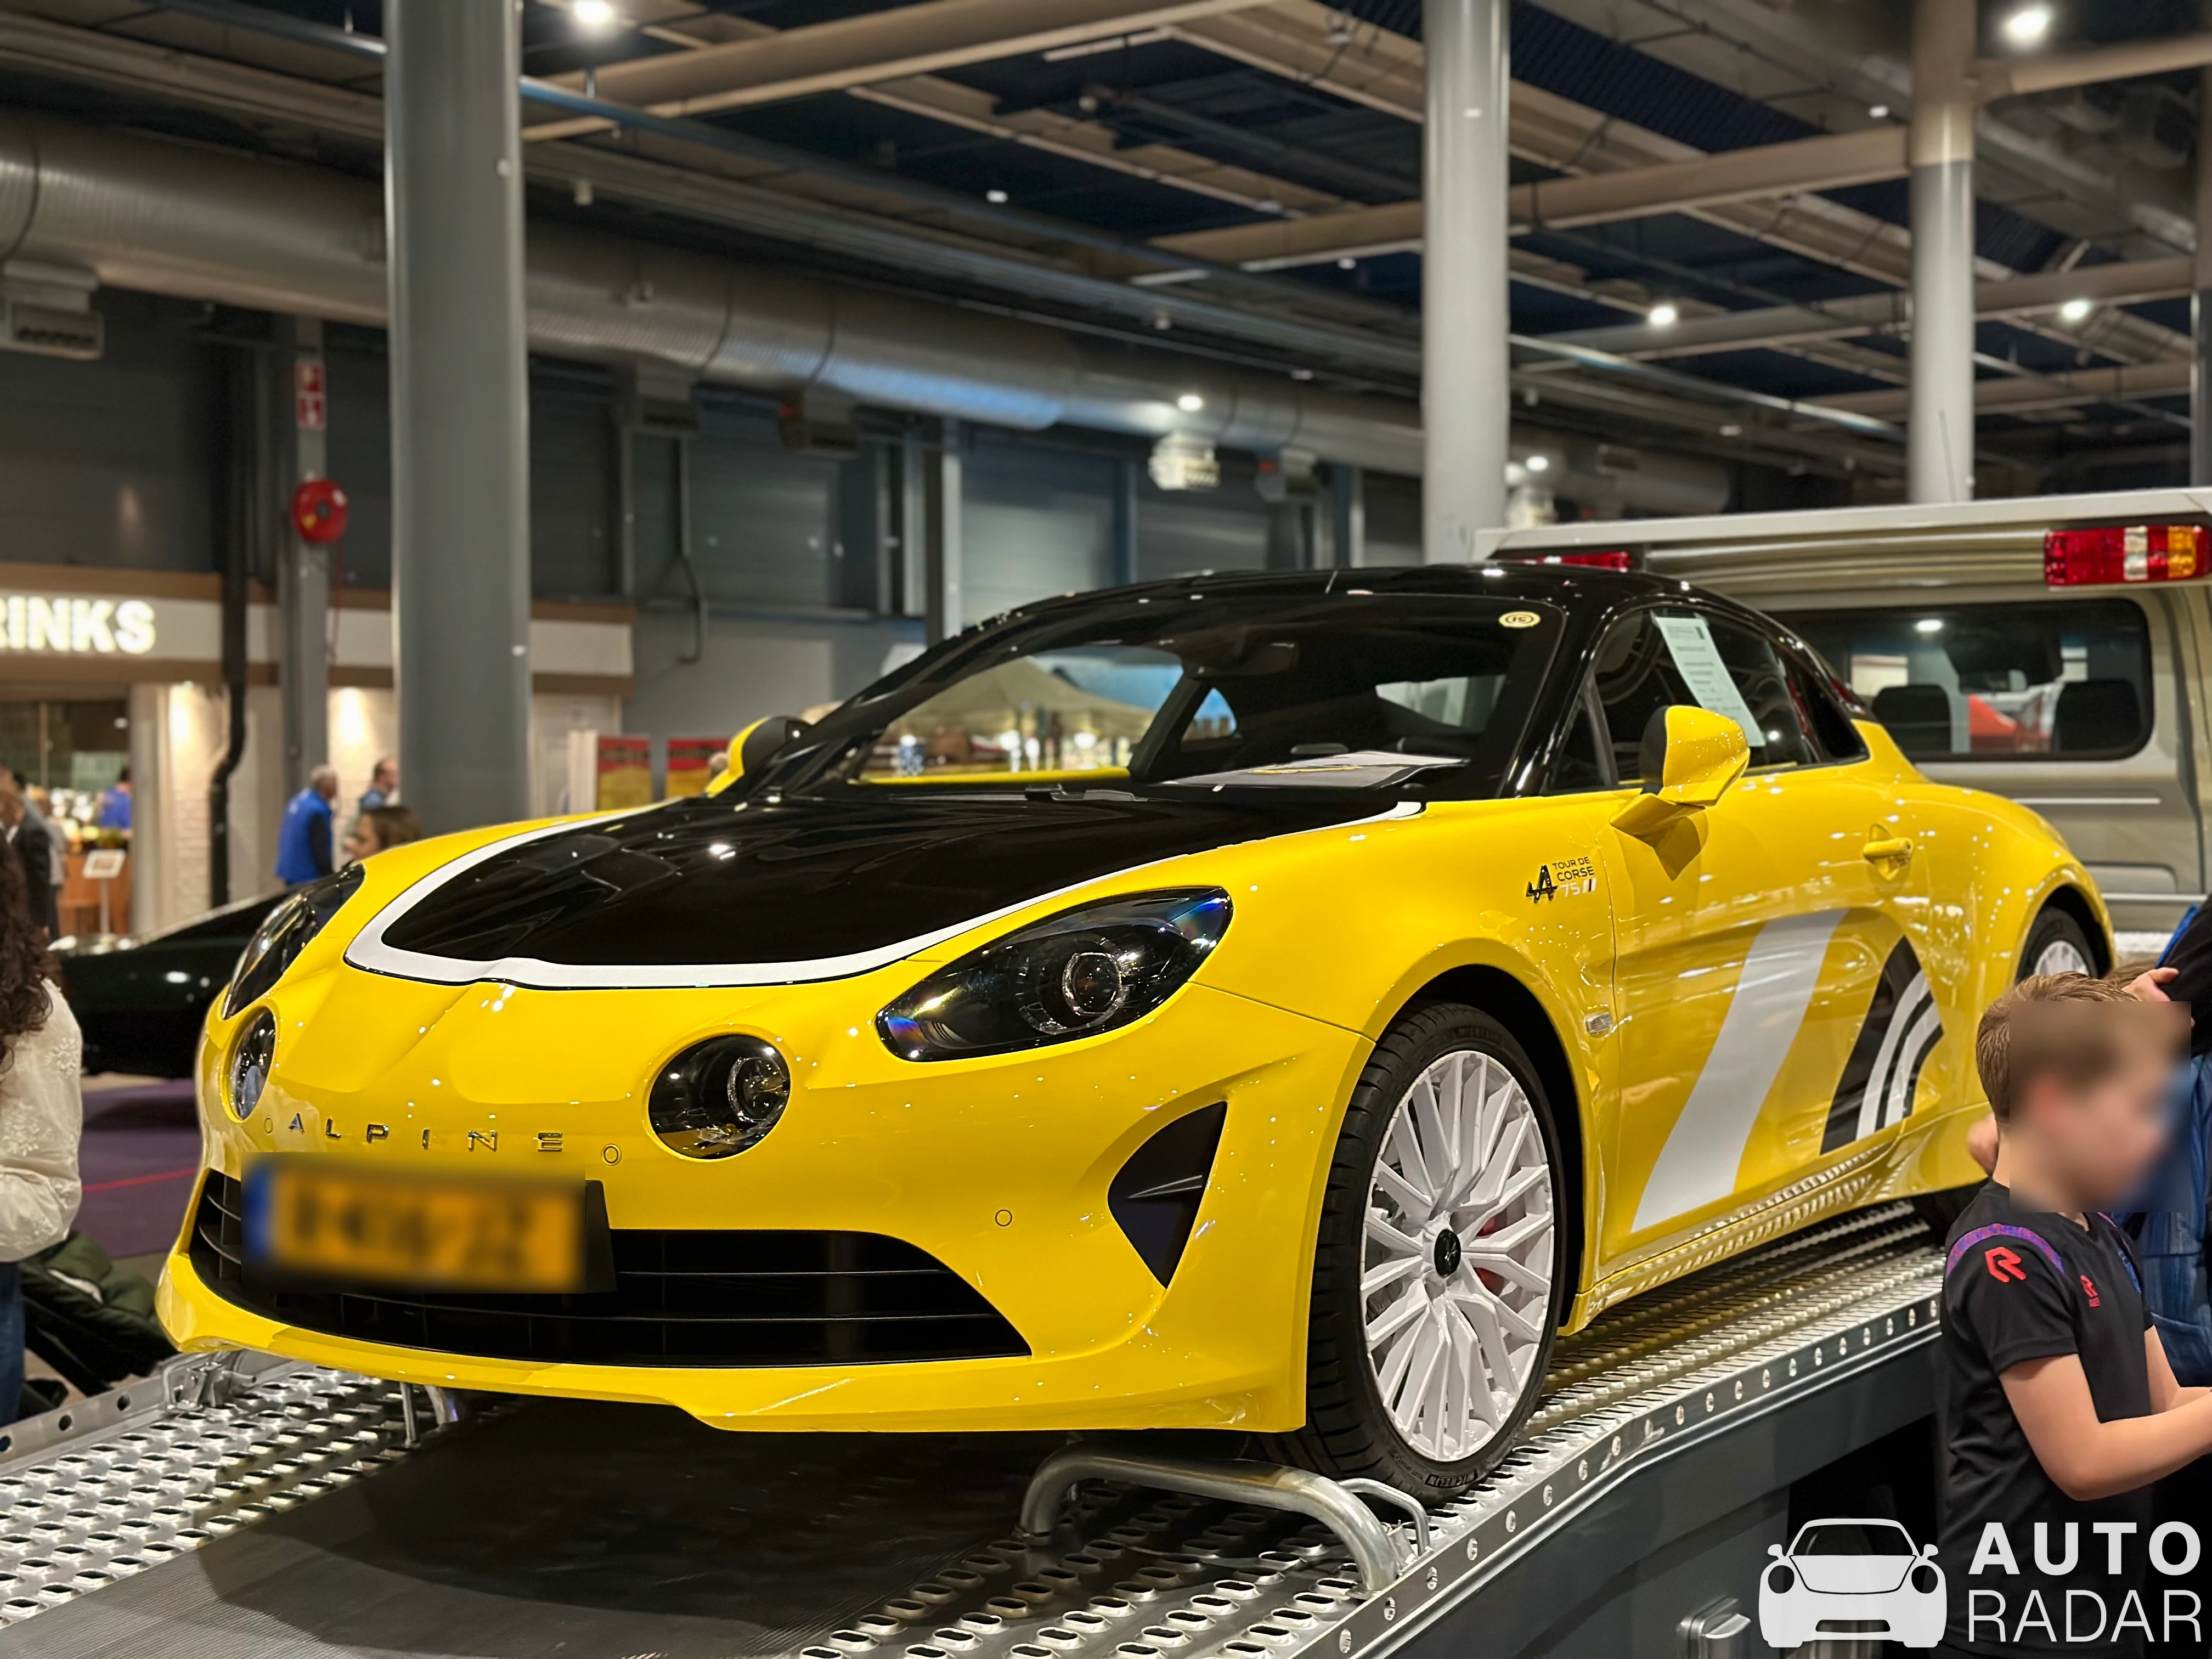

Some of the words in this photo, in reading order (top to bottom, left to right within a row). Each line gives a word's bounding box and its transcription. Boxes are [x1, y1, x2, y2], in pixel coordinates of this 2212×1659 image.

[0, 595, 156, 654] INKS
[1552, 859, 1577, 870] TOUR
[1577, 856, 1590, 865] DE
[1557, 866, 1595, 882] CORSE
[288, 1113, 563, 1152] ALPINE
